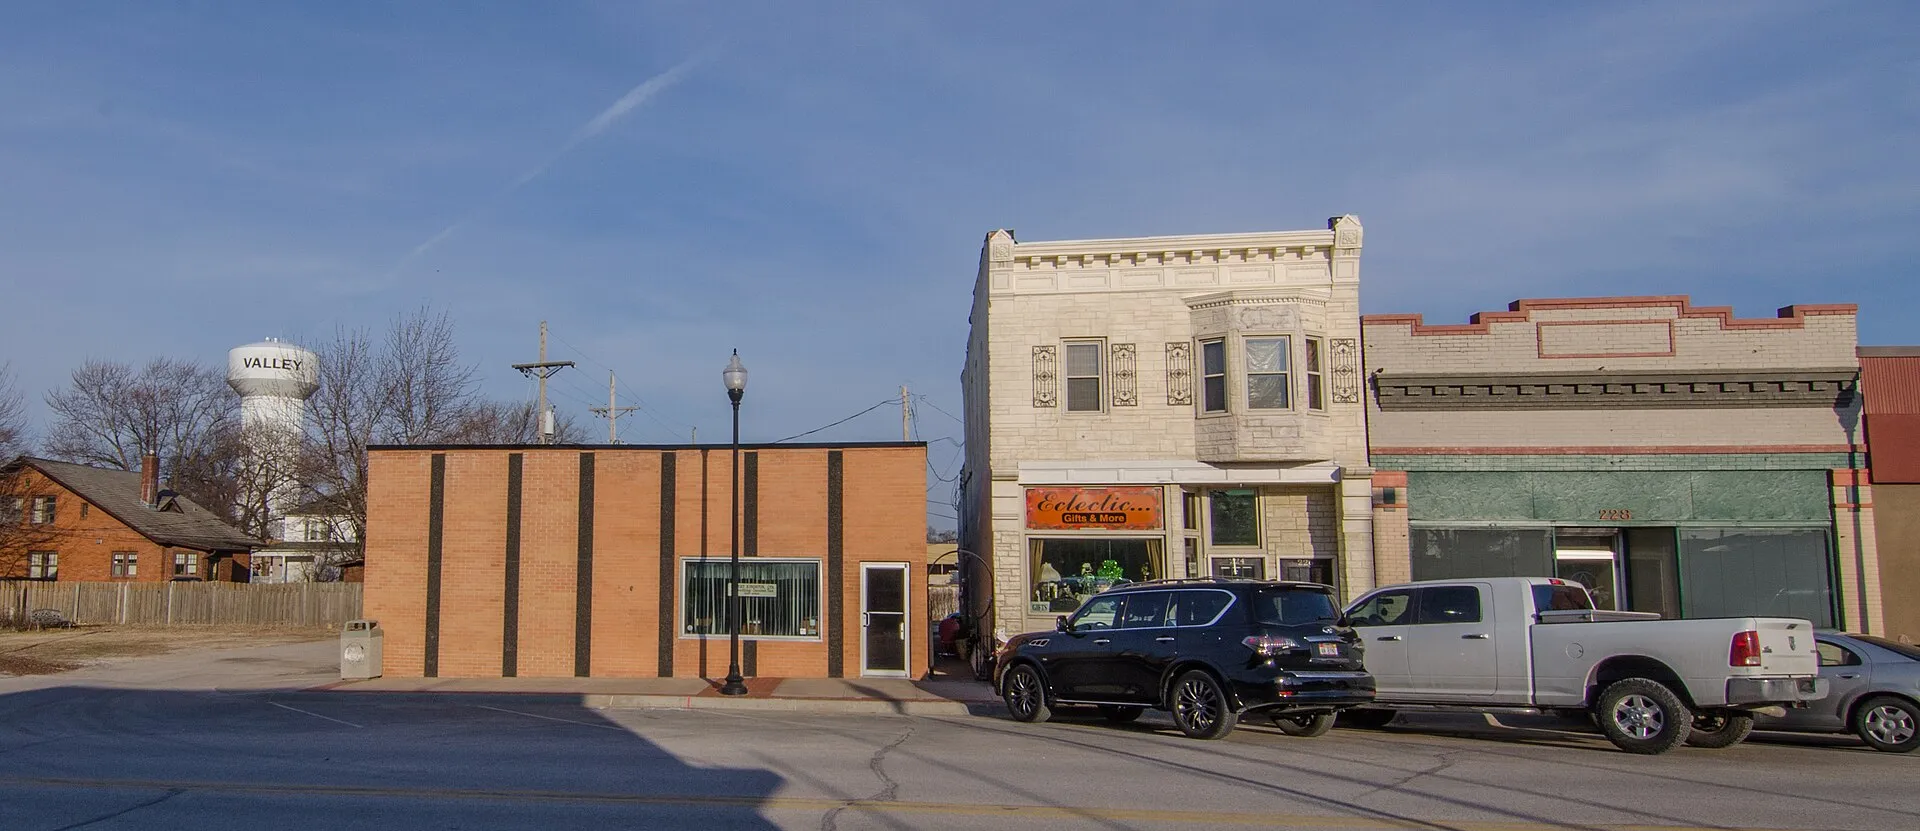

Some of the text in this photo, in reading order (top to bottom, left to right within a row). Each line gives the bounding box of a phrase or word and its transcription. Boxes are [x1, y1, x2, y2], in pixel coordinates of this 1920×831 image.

[243, 357, 302, 371] VALLEY
[1037, 492, 1151, 512] Eclectic...
[1063, 513, 1125, 523] Gifts & More
[1598, 509, 1632, 521] 228
